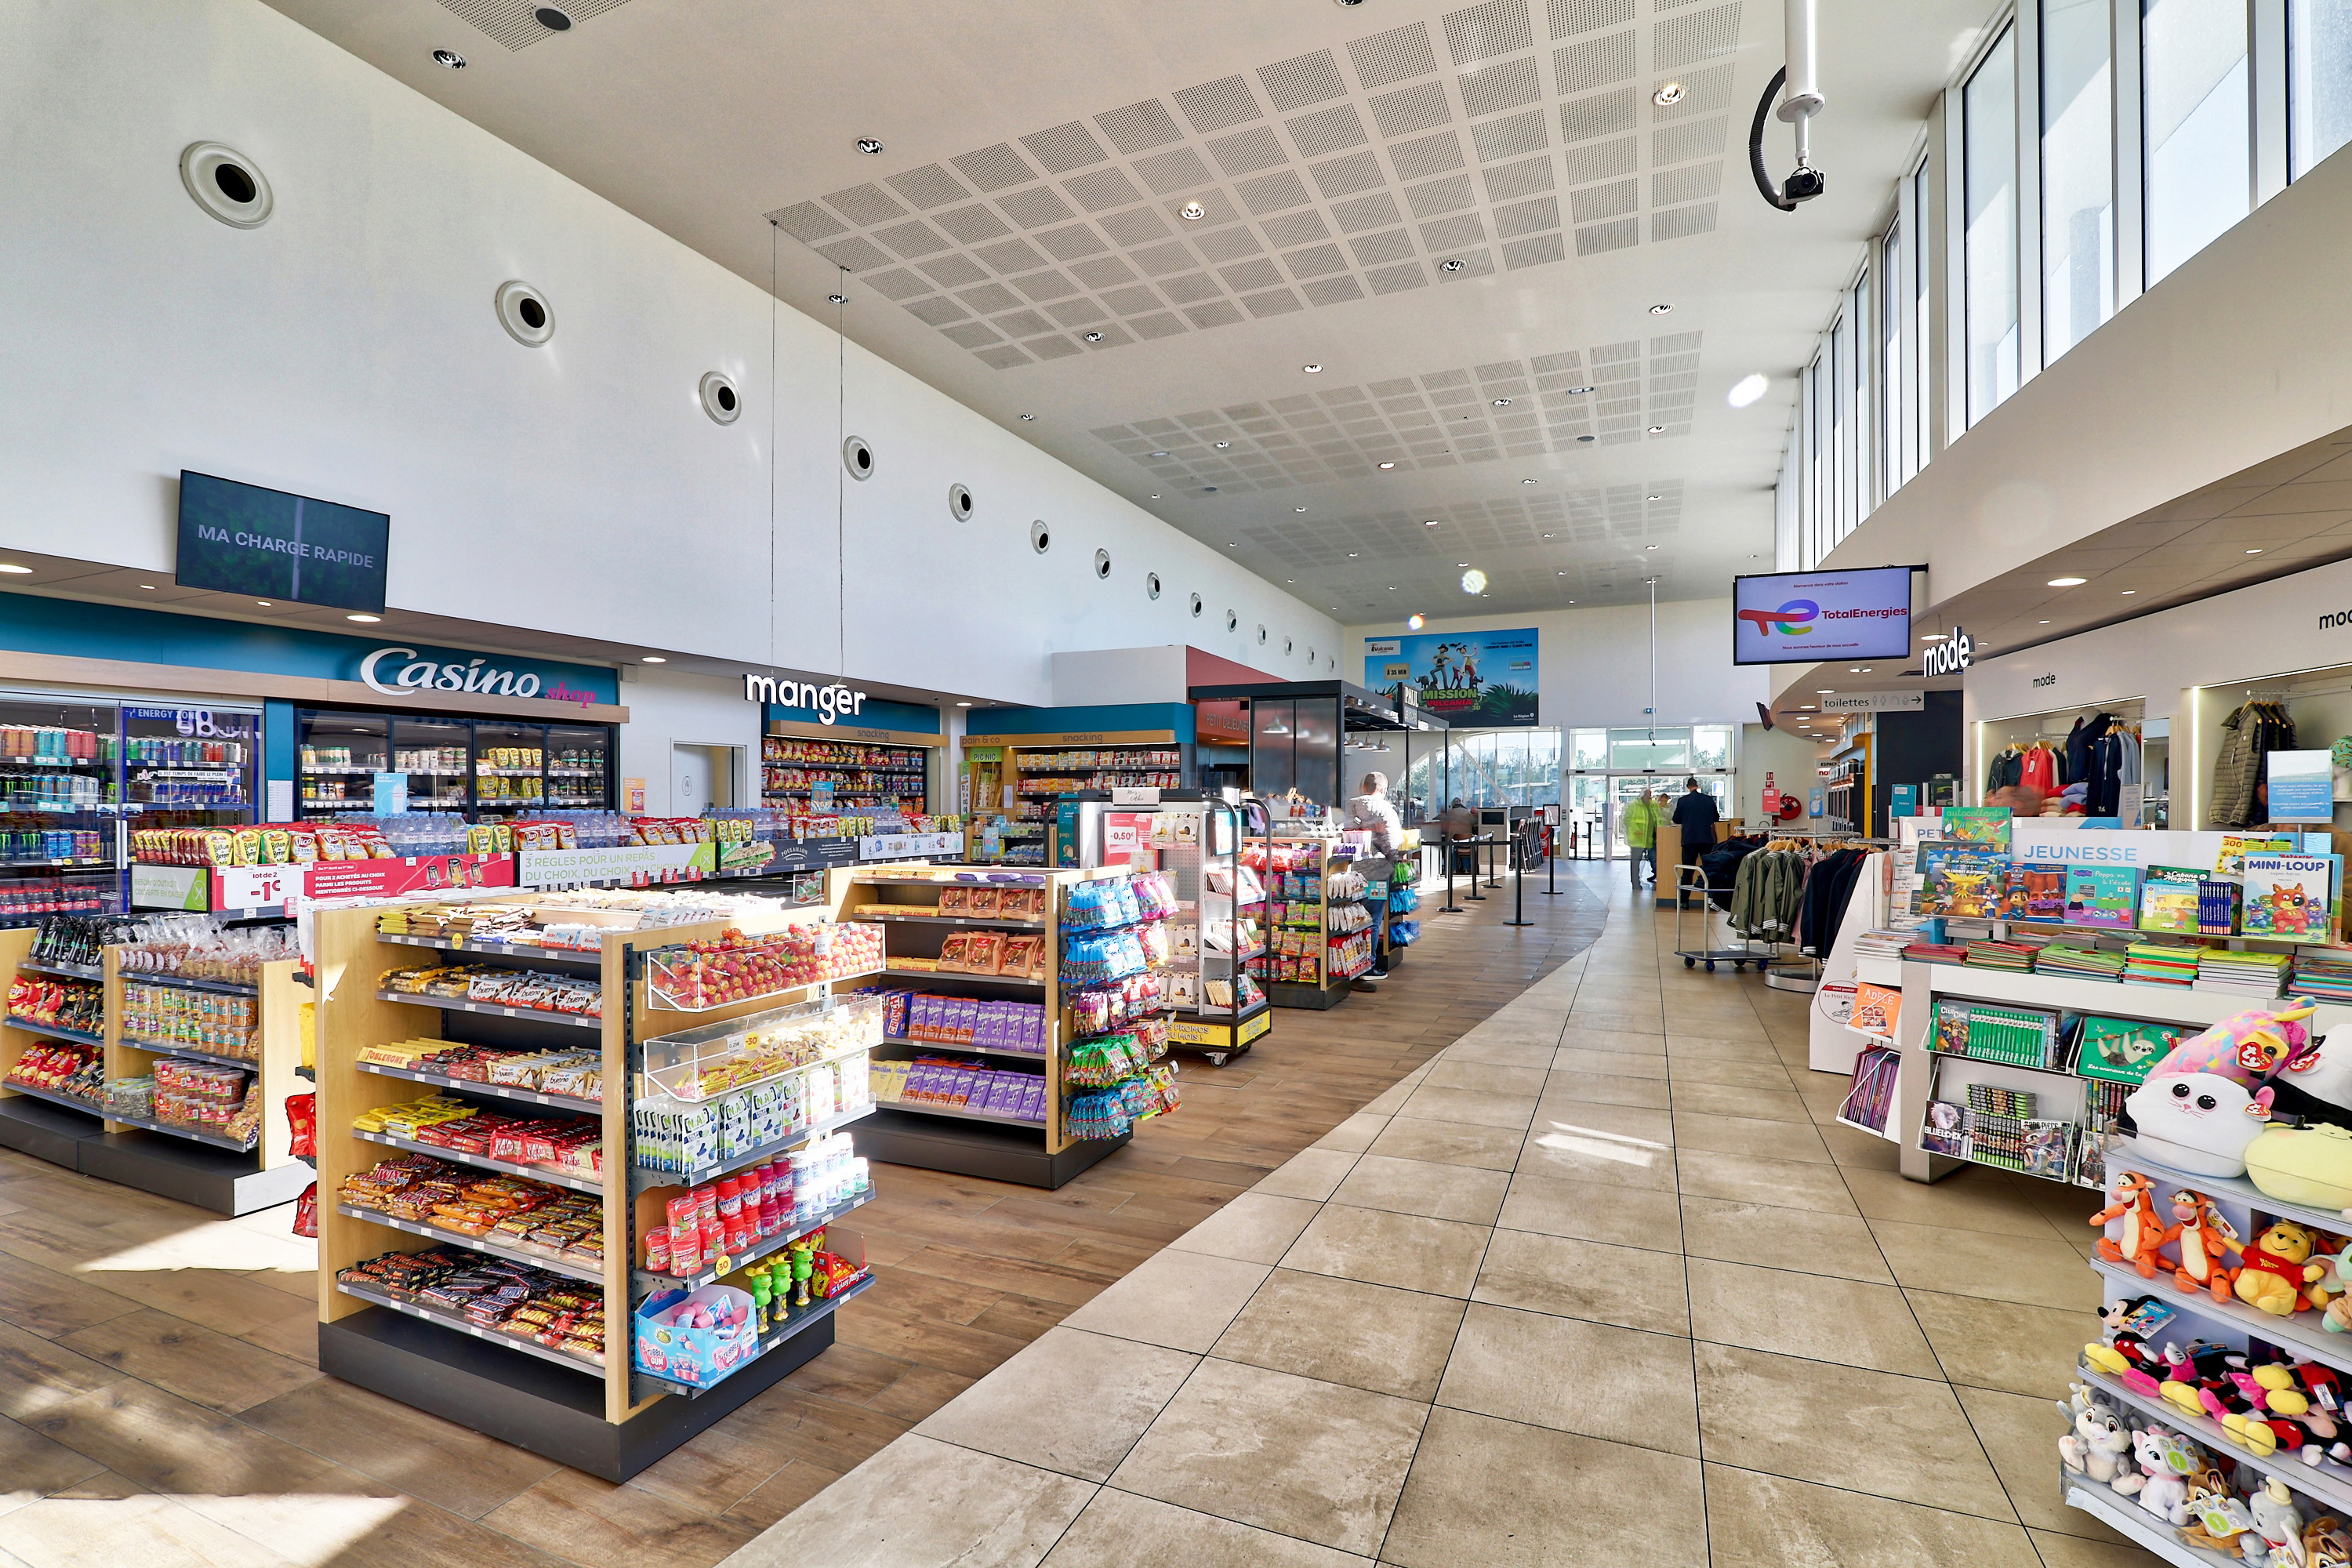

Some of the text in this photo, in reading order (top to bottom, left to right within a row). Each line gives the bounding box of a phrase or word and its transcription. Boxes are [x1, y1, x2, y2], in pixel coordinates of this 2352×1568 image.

[198, 524, 373, 568] MA CHARGE RAPIDE
[1822, 606, 1907, 619] TotalEnergies
[2319, 609, 2352, 630] mo
[1923, 626, 1970, 678] mode
[360, 648, 596, 708] Casino shop
[2032, 672, 2056, 689] mode
[746, 673, 866, 725] manger
[1404, 686, 1419, 707] PAUL
[1422, 688, 1477, 699] MISSION
[1824, 697, 1869, 708] toilettes
[138, 709, 173, 718] ENERGY
[1206, 713, 1221, 727] PETIT
[858, 729, 889, 742] snacking
[962, 735, 980, 746] pain
[1062, 732, 1103, 743] snacking
[1947, 808, 2003, 817] autocollants
[295, 837, 313, 847] Vico
[781, 845, 809, 857] POULAILLON
[2024, 846, 2137, 862] JEUNESSE
[526, 852, 655, 868] 3 RÈGLES POUR UN REPAS
[525, 871, 541, 881] DU
[545, 869, 580, 880] CHOIX,
[584, 868, 597, 877] DU
[601, 866, 632, 877] CHOIX,
[652, 862, 678, 872] CHOIX
[2249, 860, 2325, 872] MINI-LOUP
[2095, 870, 2114, 879] Peppa
[2163, 873, 2197, 884] Magique
[2171, 870, 2198, 879] Cabane
[135, 889, 159, 898] COUVERTS
[251, 880, 281, 901] -1€
[566, 995, 586, 1004] bueno
[910, 1004, 926, 1014] Milka
[944, 1006, 960, 1015] Milka
[1940, 1006, 1955, 1014] CLUB
[889, 996, 900, 1034] CRUNCH
[990, 1011, 1007, 1020] Milka
[1023, 1015, 1040, 1025] Milka
[1174, 1024, 1209, 1033] PROMOS
[365, 1049, 405, 1065] TOBLERONE
[2241, 1045, 2261, 1068] ty
[2291, 1054, 2314, 1069] ty
[2100, 1065, 2125, 1075] animaux
[550, 1075, 569, 1084] bueno
[924, 1071, 940, 1081] Milka
[956, 1074, 973, 1083] Milka
[991, 1080, 1007, 1089] Milka
[1025, 1083, 1042, 1092] Milka
[2246, 1104, 2262, 1115] ty
[2085, 1133, 2093, 1142] 18
[374, 1167, 400, 1180] TWIX
[719, 1194, 742, 1207] mentos
[716, 1261, 728, 1271] -30
[2147, 1304, 2166, 1314] MICKEY
[520, 1308, 550, 1323] LION
[647, 1348, 665, 1358] TUBBLE
[723, 1341, 740, 1358] TUBBLE
[650, 1356, 664, 1367] GUM
[725, 1350, 739, 1364] GUM
[2318, 1386, 2328, 1406] Disney
